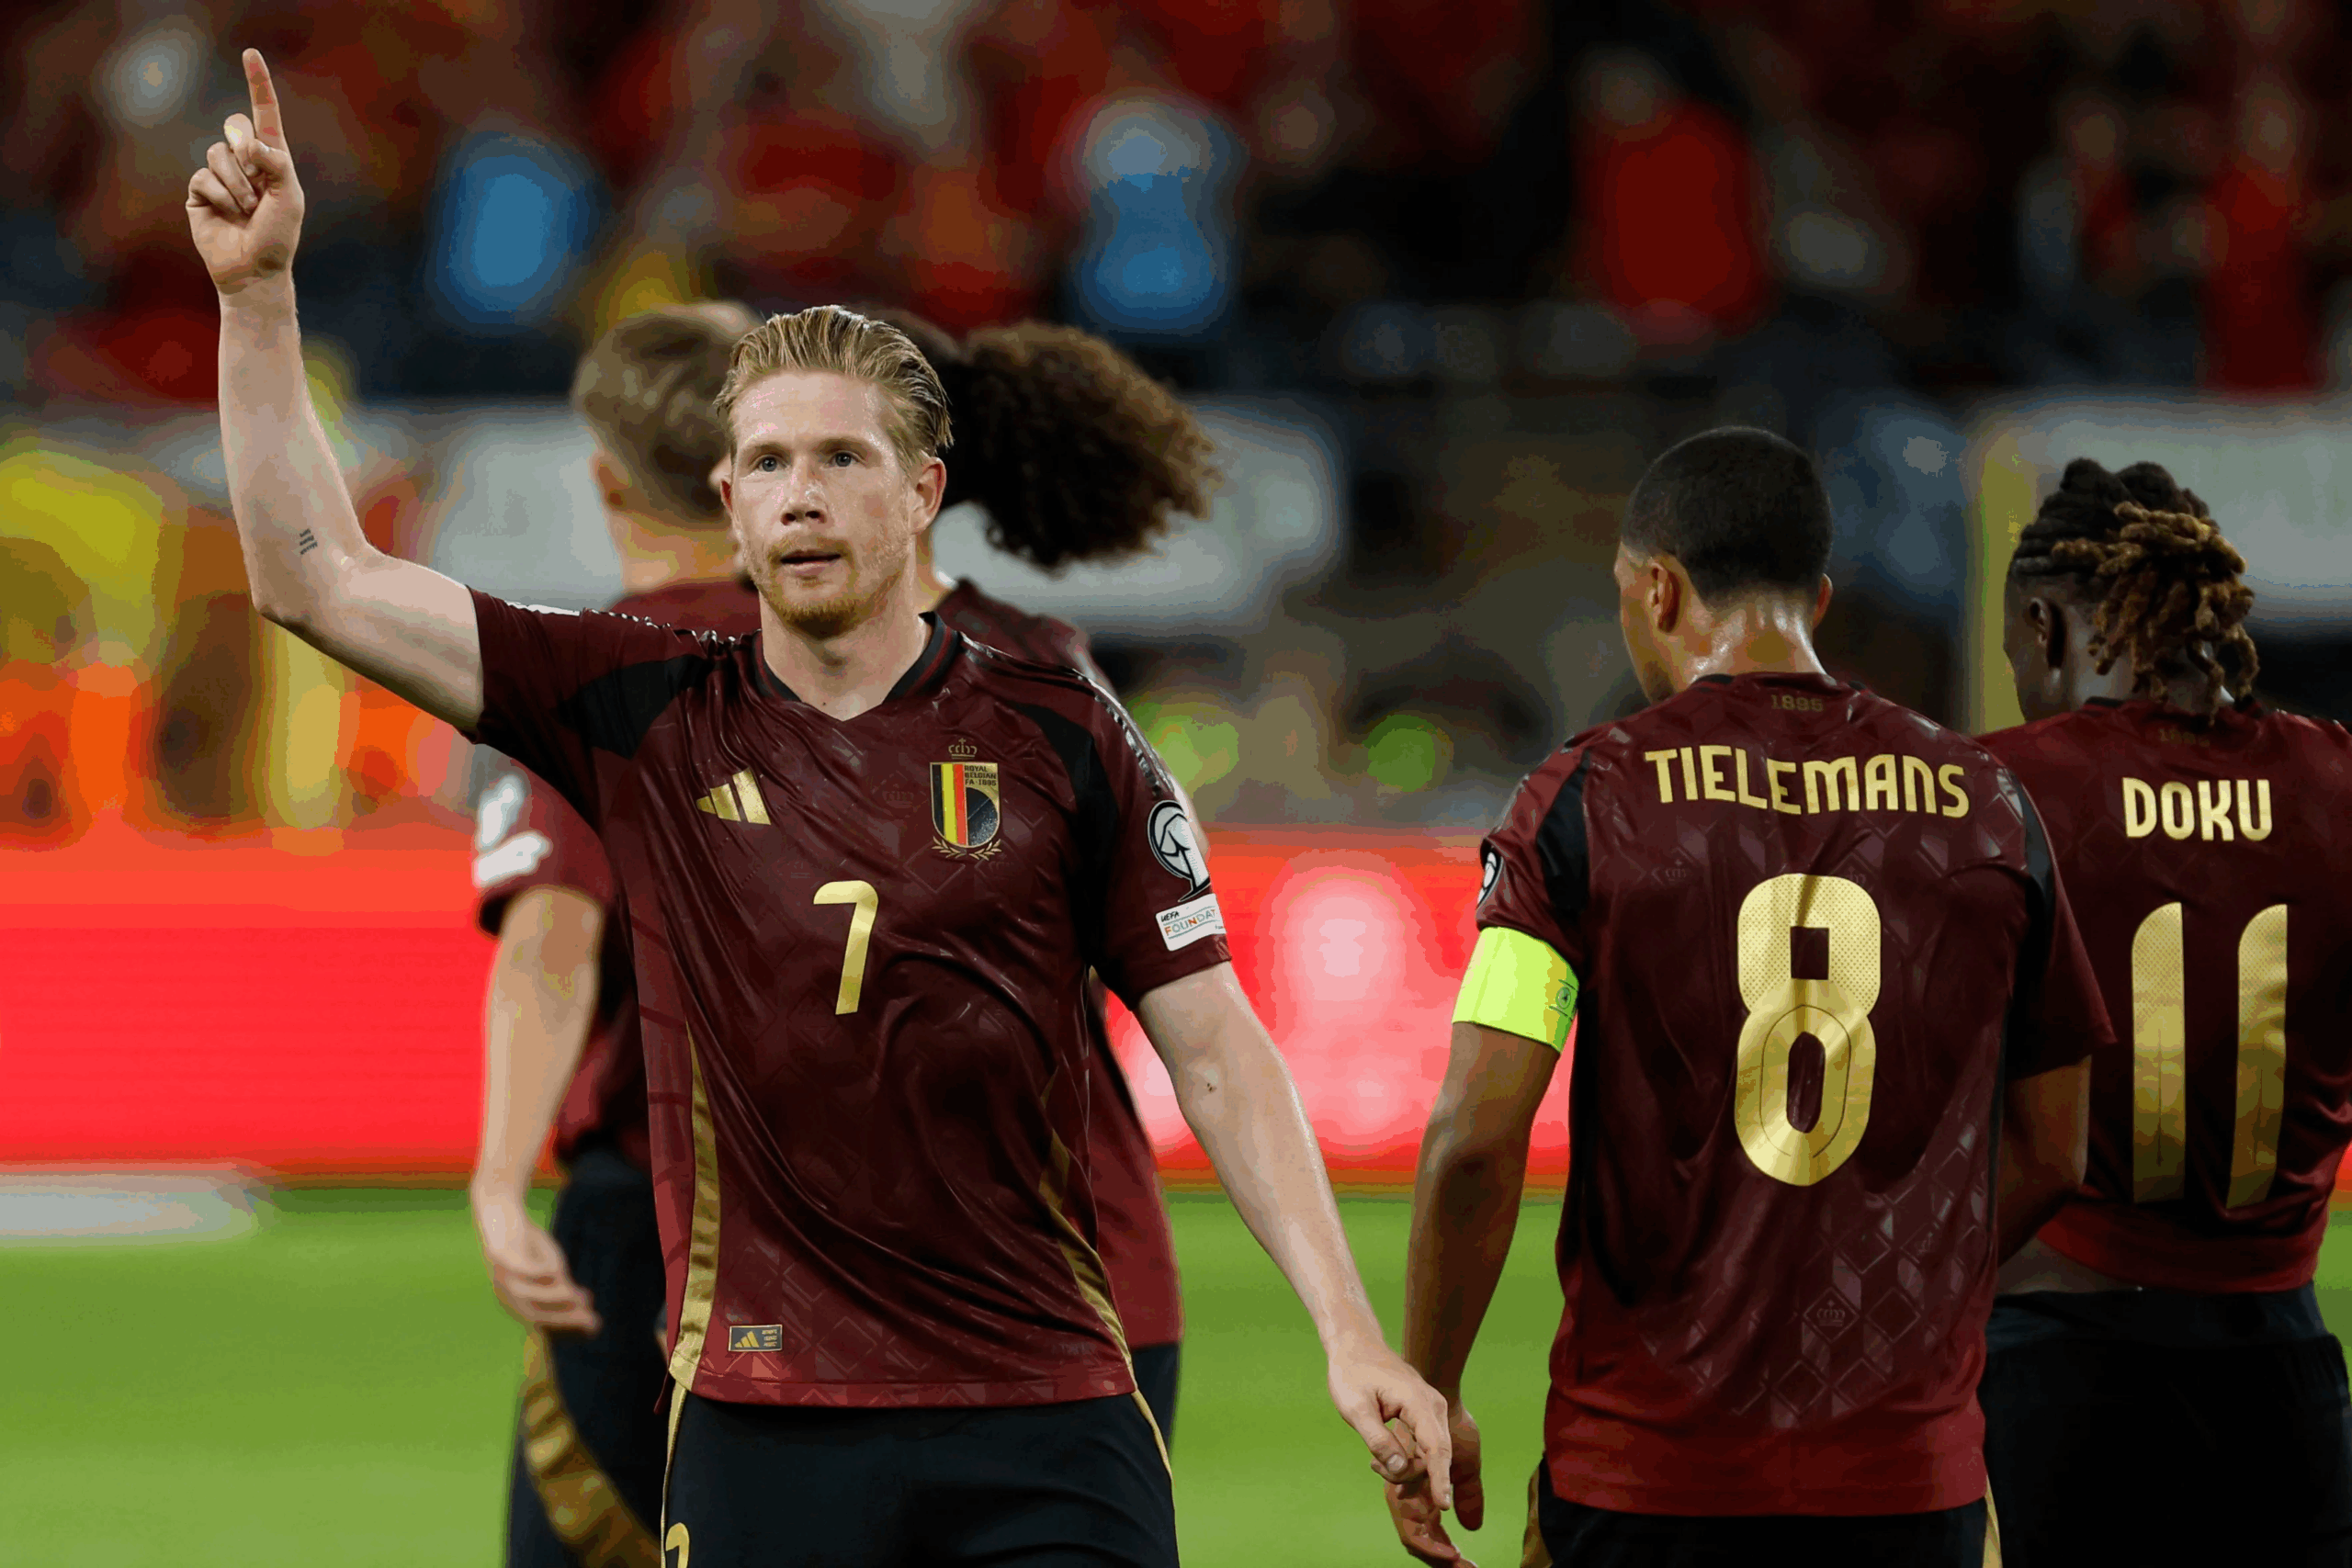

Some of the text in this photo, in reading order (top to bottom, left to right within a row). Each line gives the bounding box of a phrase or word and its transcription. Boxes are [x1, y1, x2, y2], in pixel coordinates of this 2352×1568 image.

[1770, 694, 1824, 712] 1895
[1645, 745, 1970, 818] TIELEMANS
[2122, 777, 2273, 841] DOKU
[813, 879, 879, 1015] 7
[1160, 910, 1181, 922] UEFA
[1734, 873, 1882, 1187] 8
[2132, 901, 2289, 1208] 11
